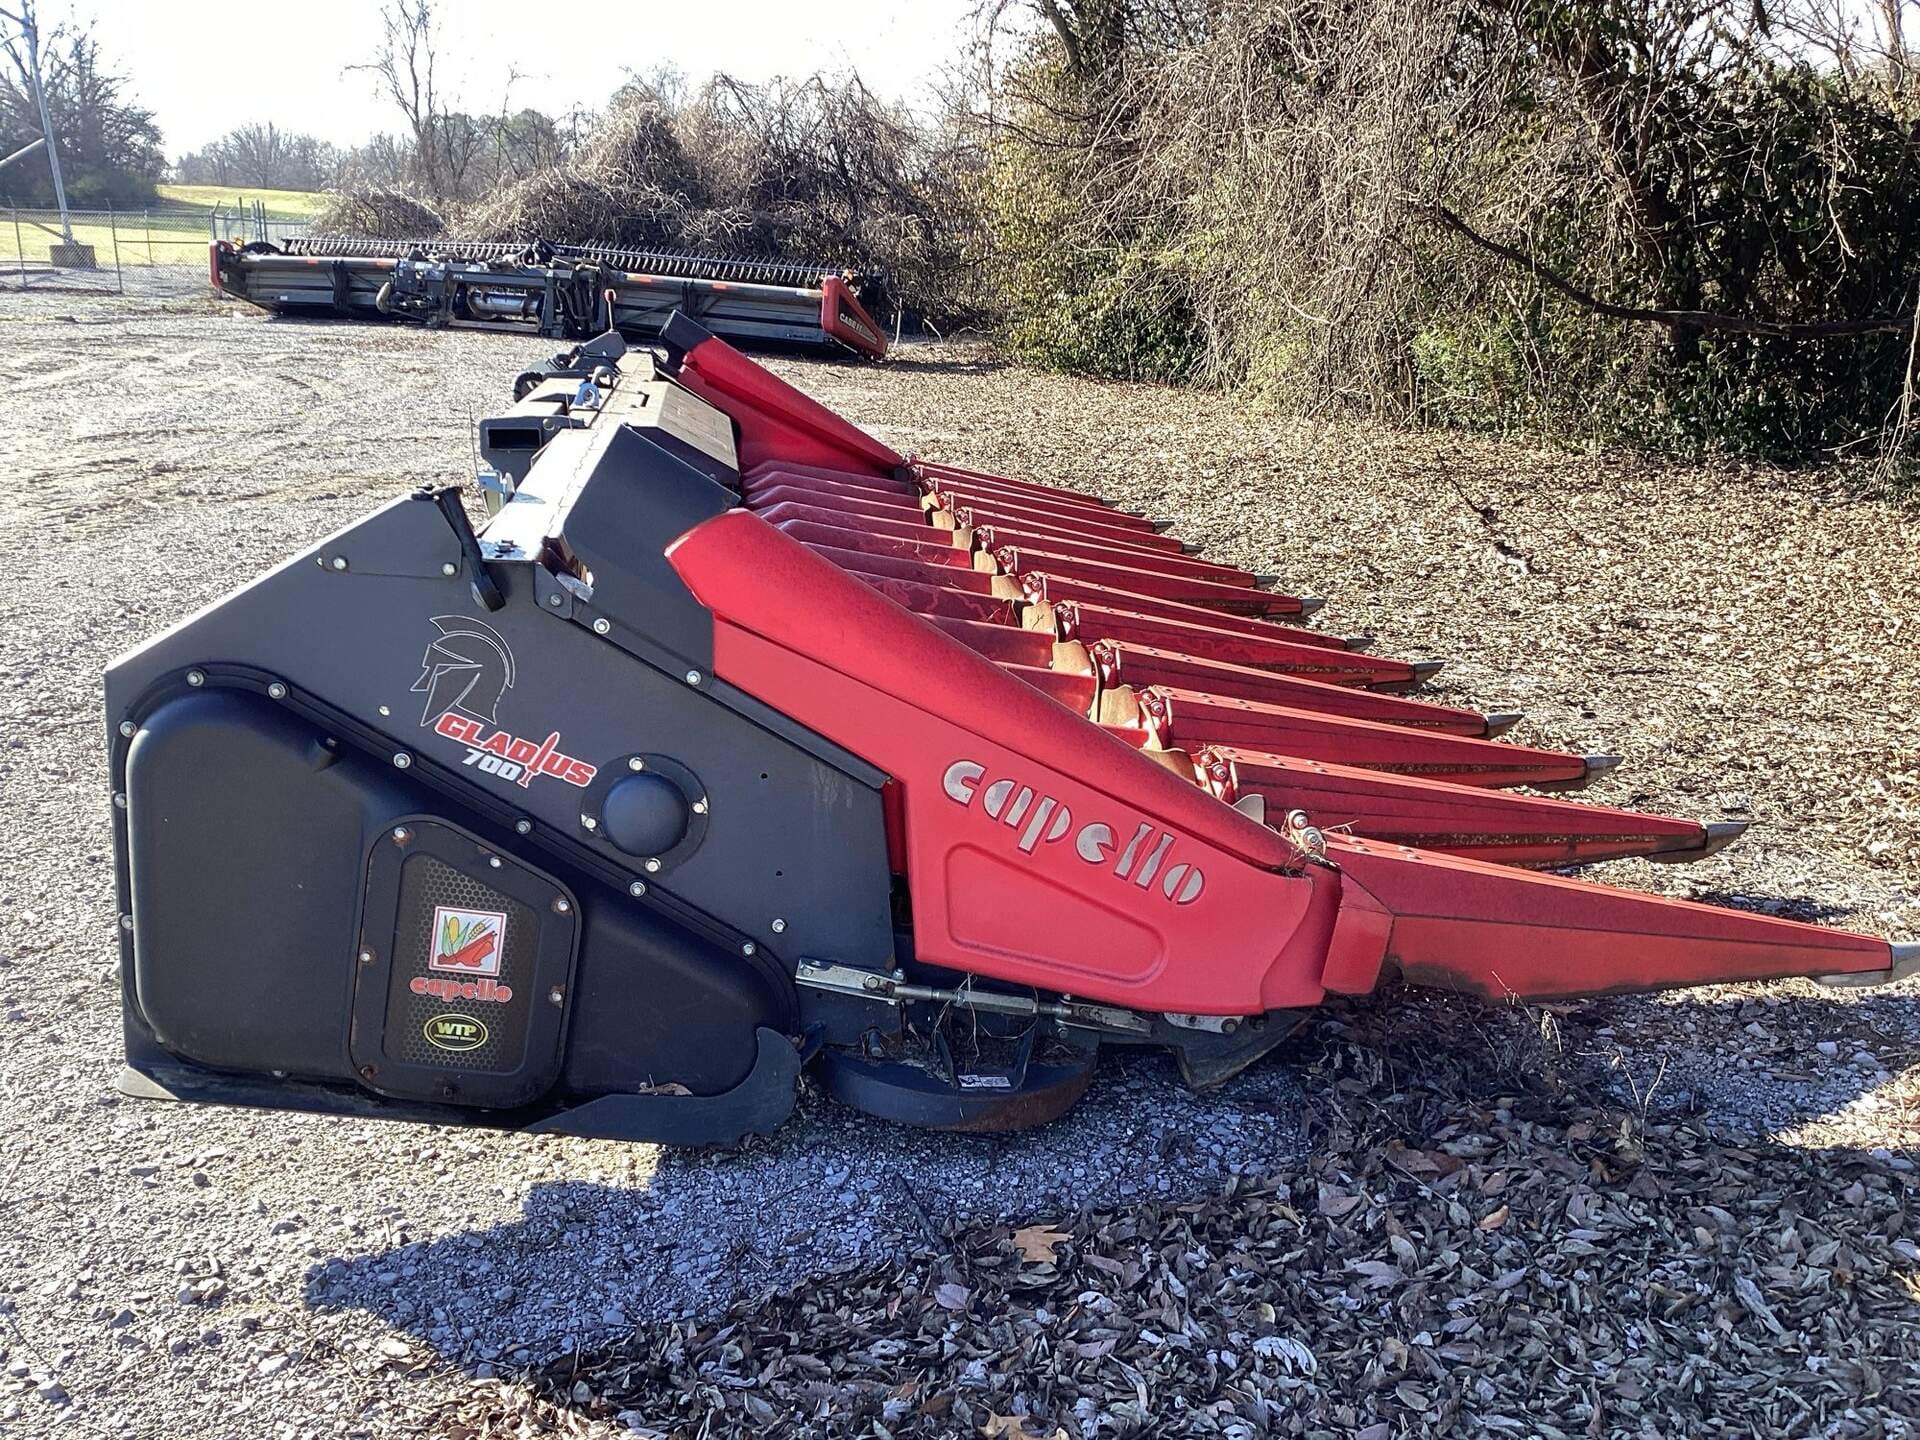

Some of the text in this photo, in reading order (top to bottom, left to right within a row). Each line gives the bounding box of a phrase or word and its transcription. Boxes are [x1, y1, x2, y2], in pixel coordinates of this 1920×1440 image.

[941, 759, 1205, 905] capello
[409, 976, 512, 1003] capello
[437, 1022, 477, 1036] WTP
